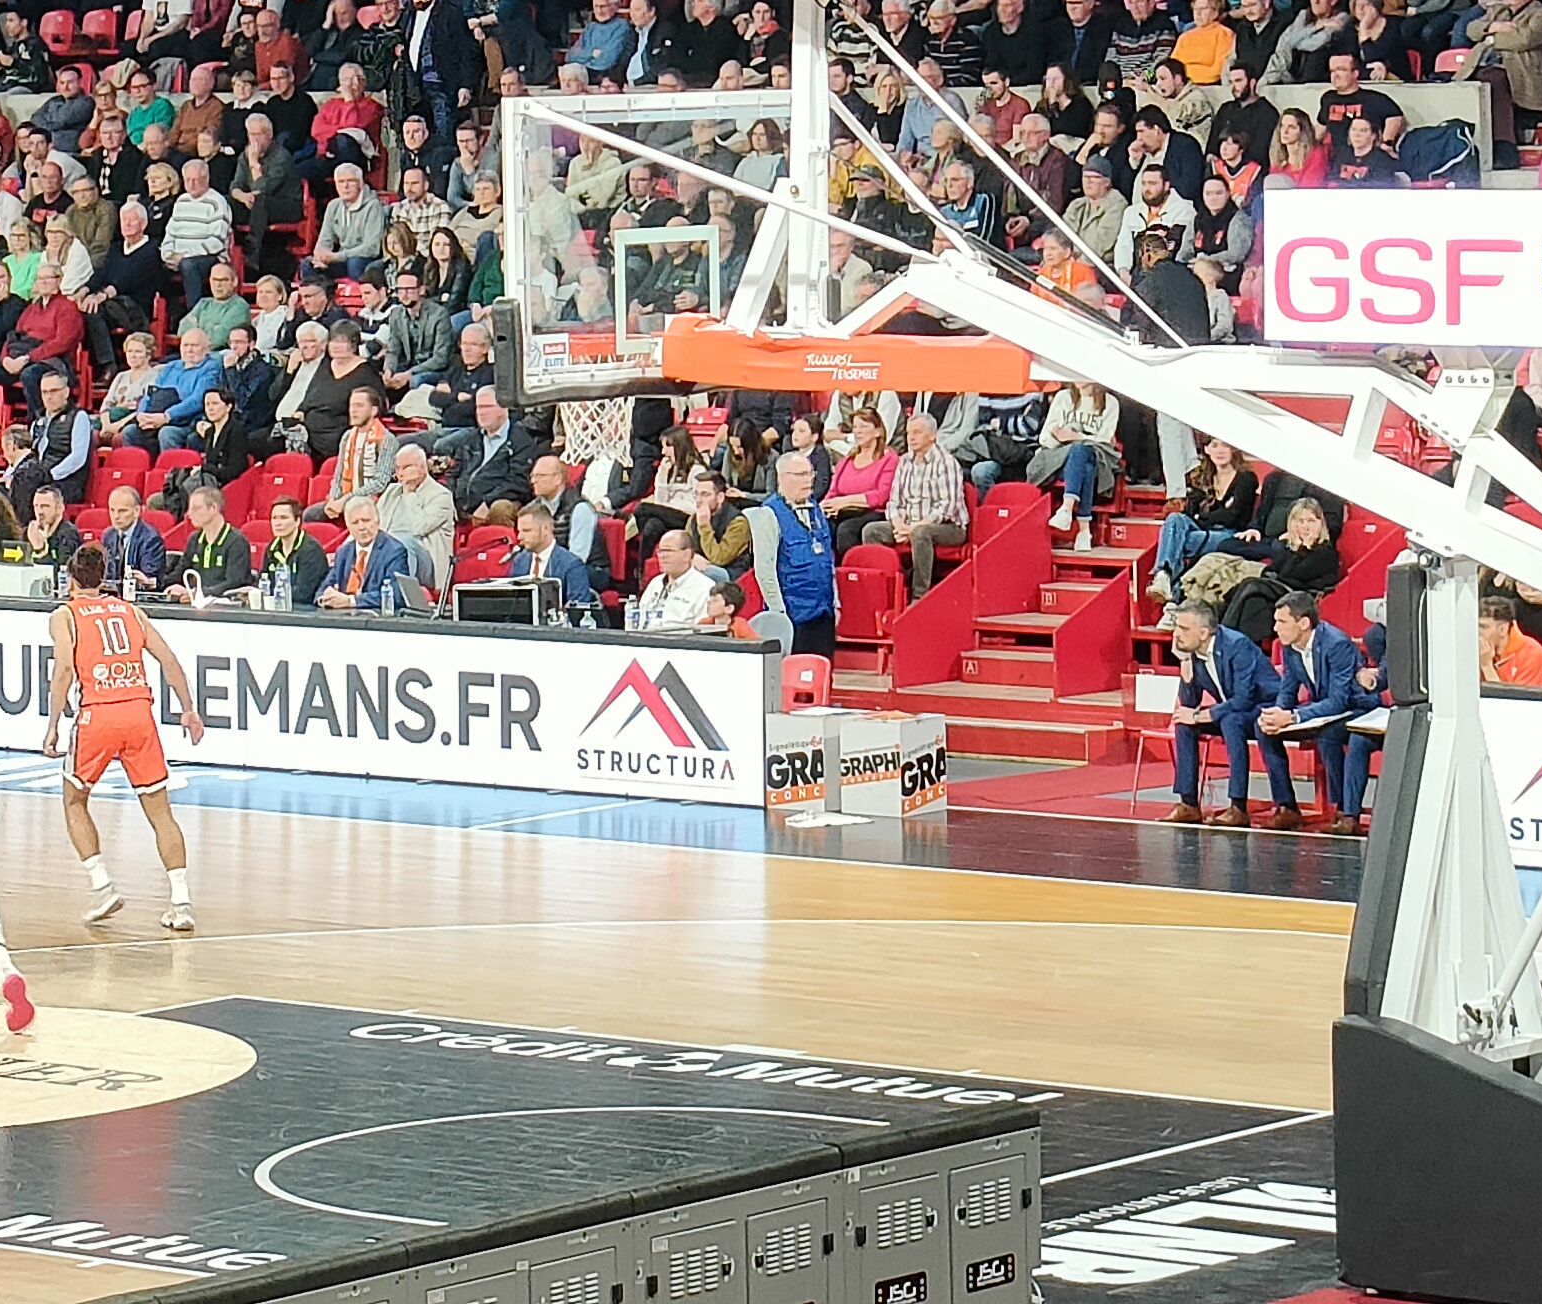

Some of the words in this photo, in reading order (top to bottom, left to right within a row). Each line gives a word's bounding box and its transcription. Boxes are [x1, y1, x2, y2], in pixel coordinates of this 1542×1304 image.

[1275, 236, 1524, 325] GSF
[95, 617, 130, 656] 10
[577, 747, 736, 781] STRUCTURA
[767, 749, 825, 790] GRA
[901, 746, 947, 797] GRA
[770, 787, 821, 802] CONC
[904, 786, 945, 811] CONC
[349, 1022, 629, 1066] Crédit
